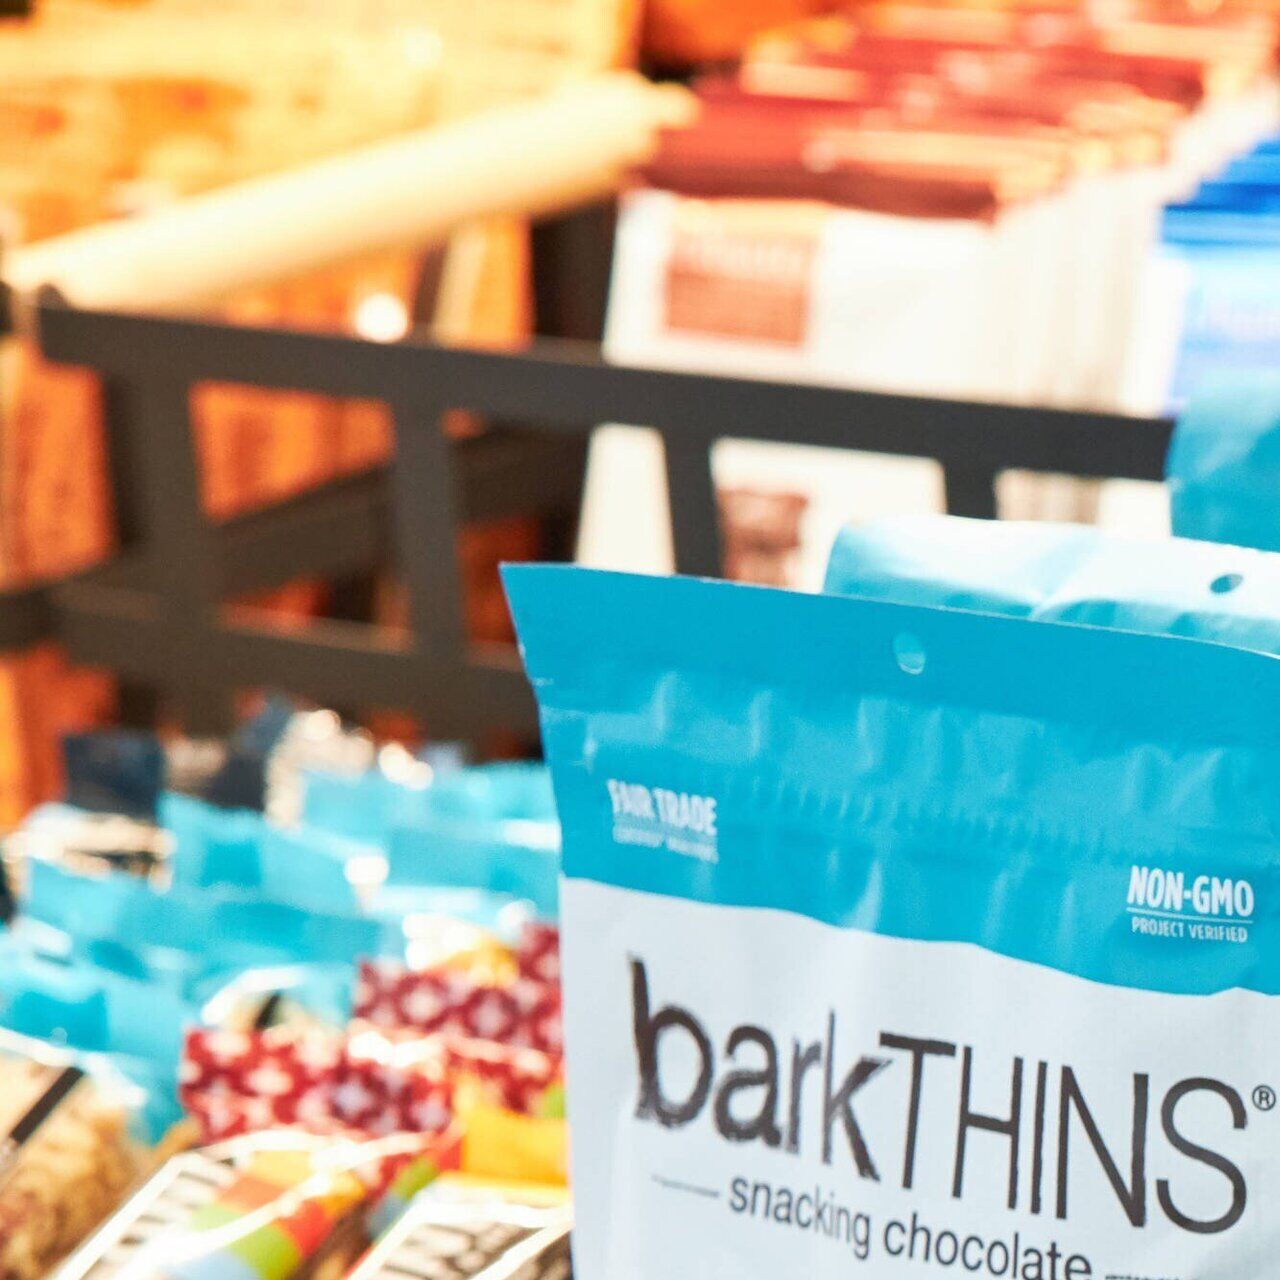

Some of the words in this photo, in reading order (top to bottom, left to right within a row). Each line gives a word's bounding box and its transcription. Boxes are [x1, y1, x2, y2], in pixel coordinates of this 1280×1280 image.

[652, 787, 717, 836] TRADE
[1127, 864, 1255, 917] NON-GMO
[1131, 916, 1184, 938] PROJECT
[1188, 924, 1248, 943] VERIFIED
[729, 1174, 871, 1260] snacking
